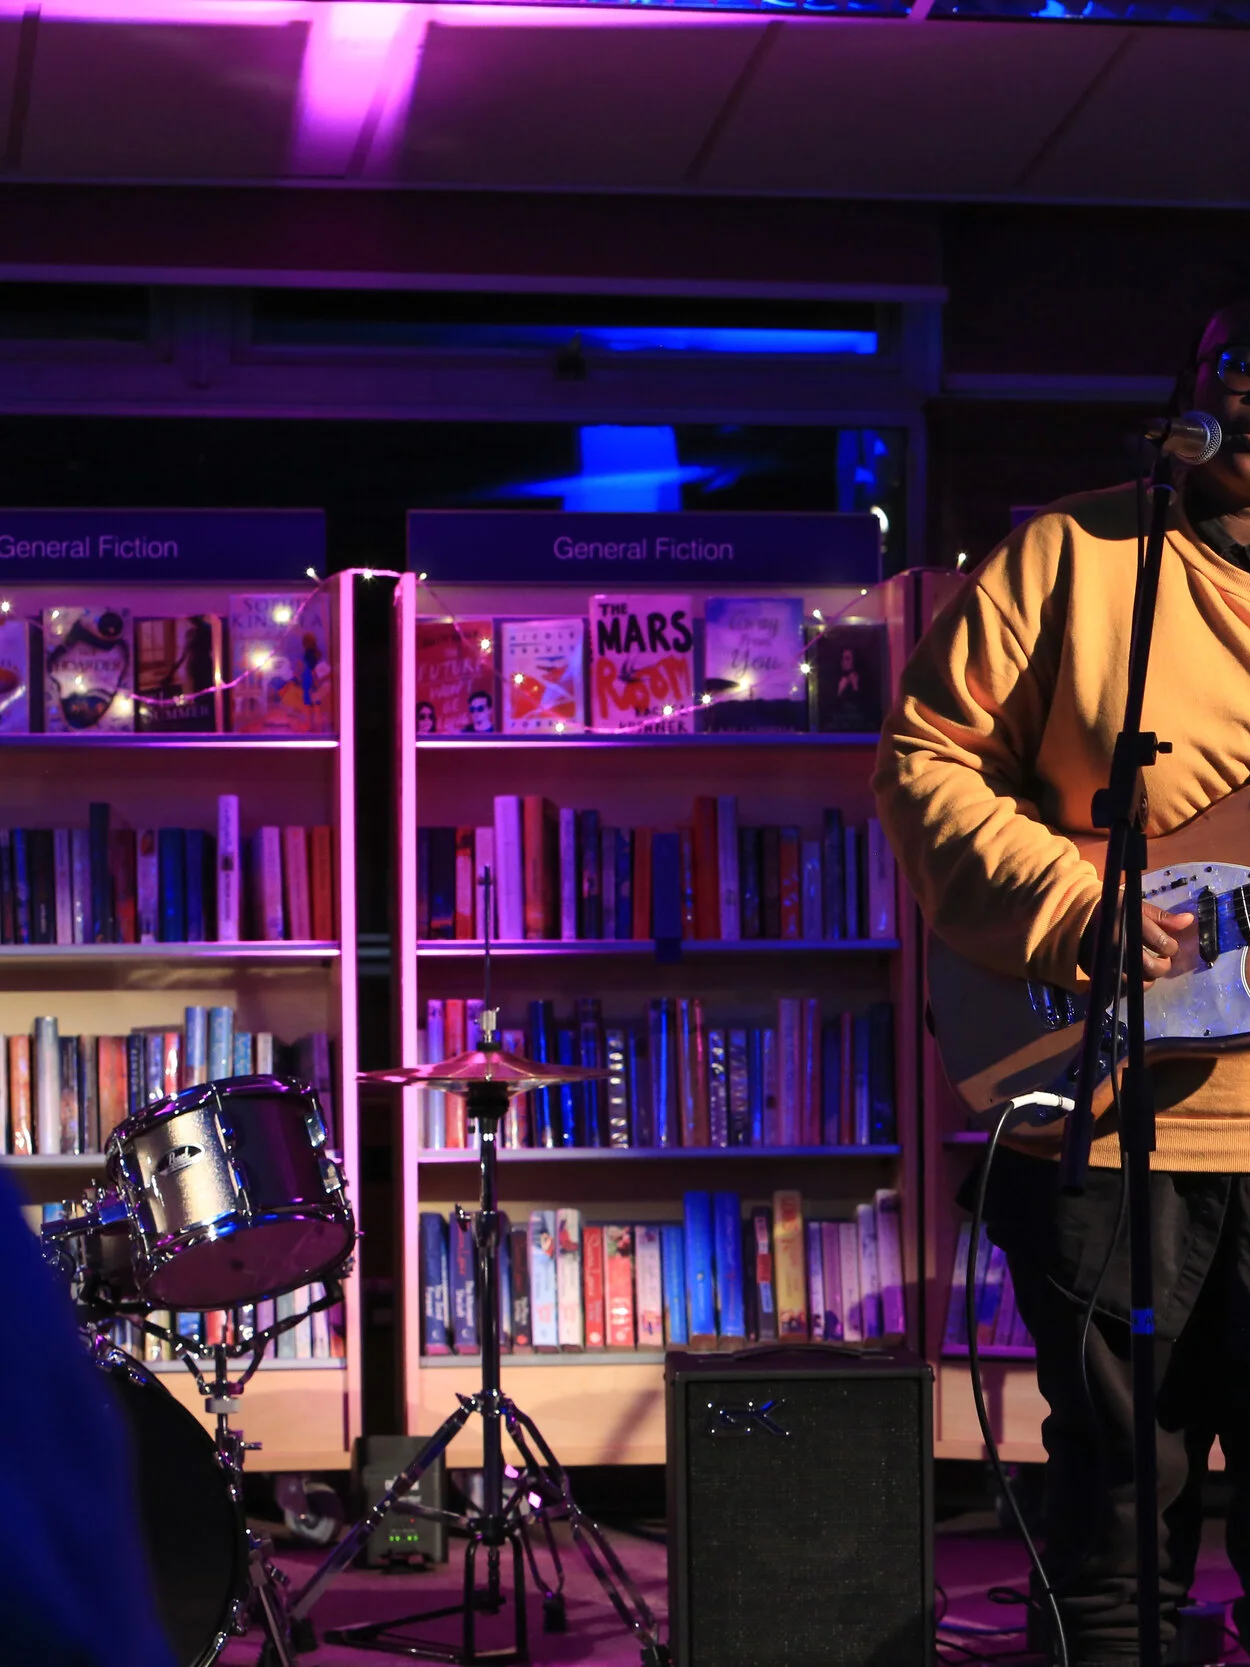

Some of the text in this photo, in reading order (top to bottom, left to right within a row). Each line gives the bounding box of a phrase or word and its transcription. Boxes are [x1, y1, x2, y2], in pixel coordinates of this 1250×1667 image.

[0, 534, 179, 559] General Fiction
[553, 535, 734, 560] General Fiction
[599, 603, 628, 616] THE
[597, 610, 693, 656] MARS
[596, 655, 692, 720] ROOM
[168, 1146, 191, 1166] Pearl
